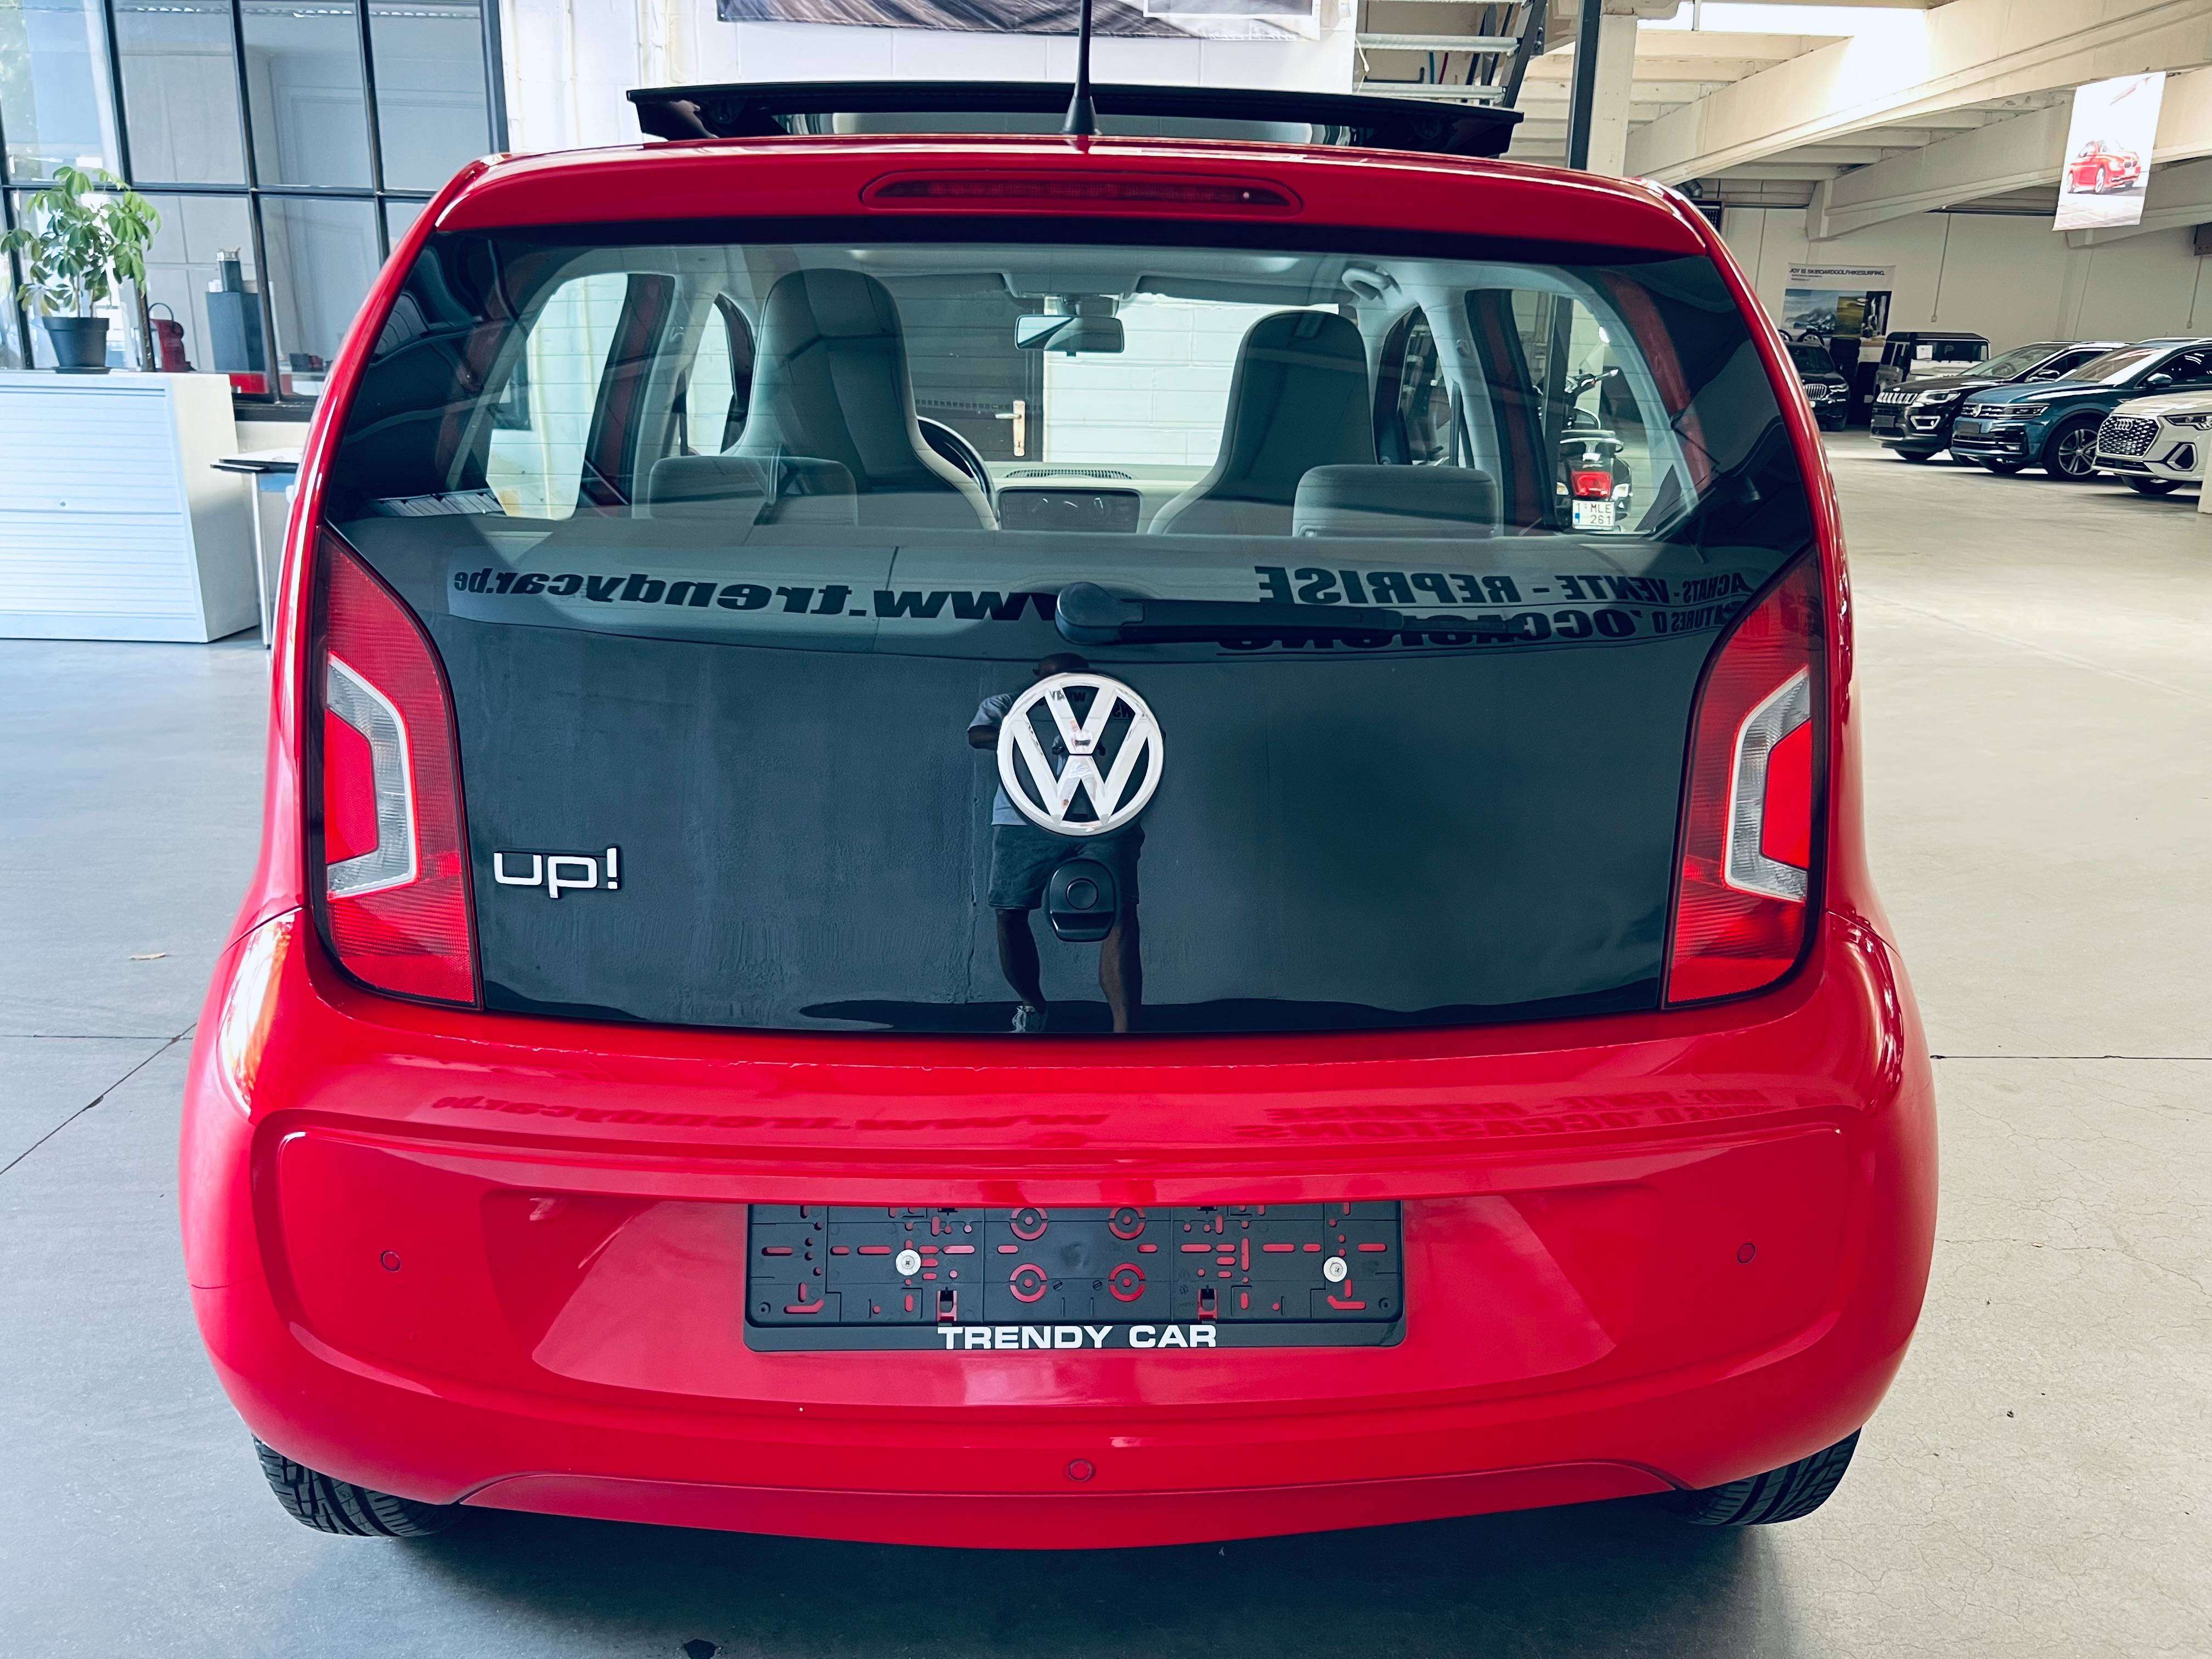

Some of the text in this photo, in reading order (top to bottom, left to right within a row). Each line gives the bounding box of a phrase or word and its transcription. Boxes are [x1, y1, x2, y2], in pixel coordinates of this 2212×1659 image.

[1590, 515, 1611, 524] 261
[997, 672, 1164, 836] VW
[494, 847, 618, 899] up!
[937, 1325, 1217, 1350] TRENDY CAR
